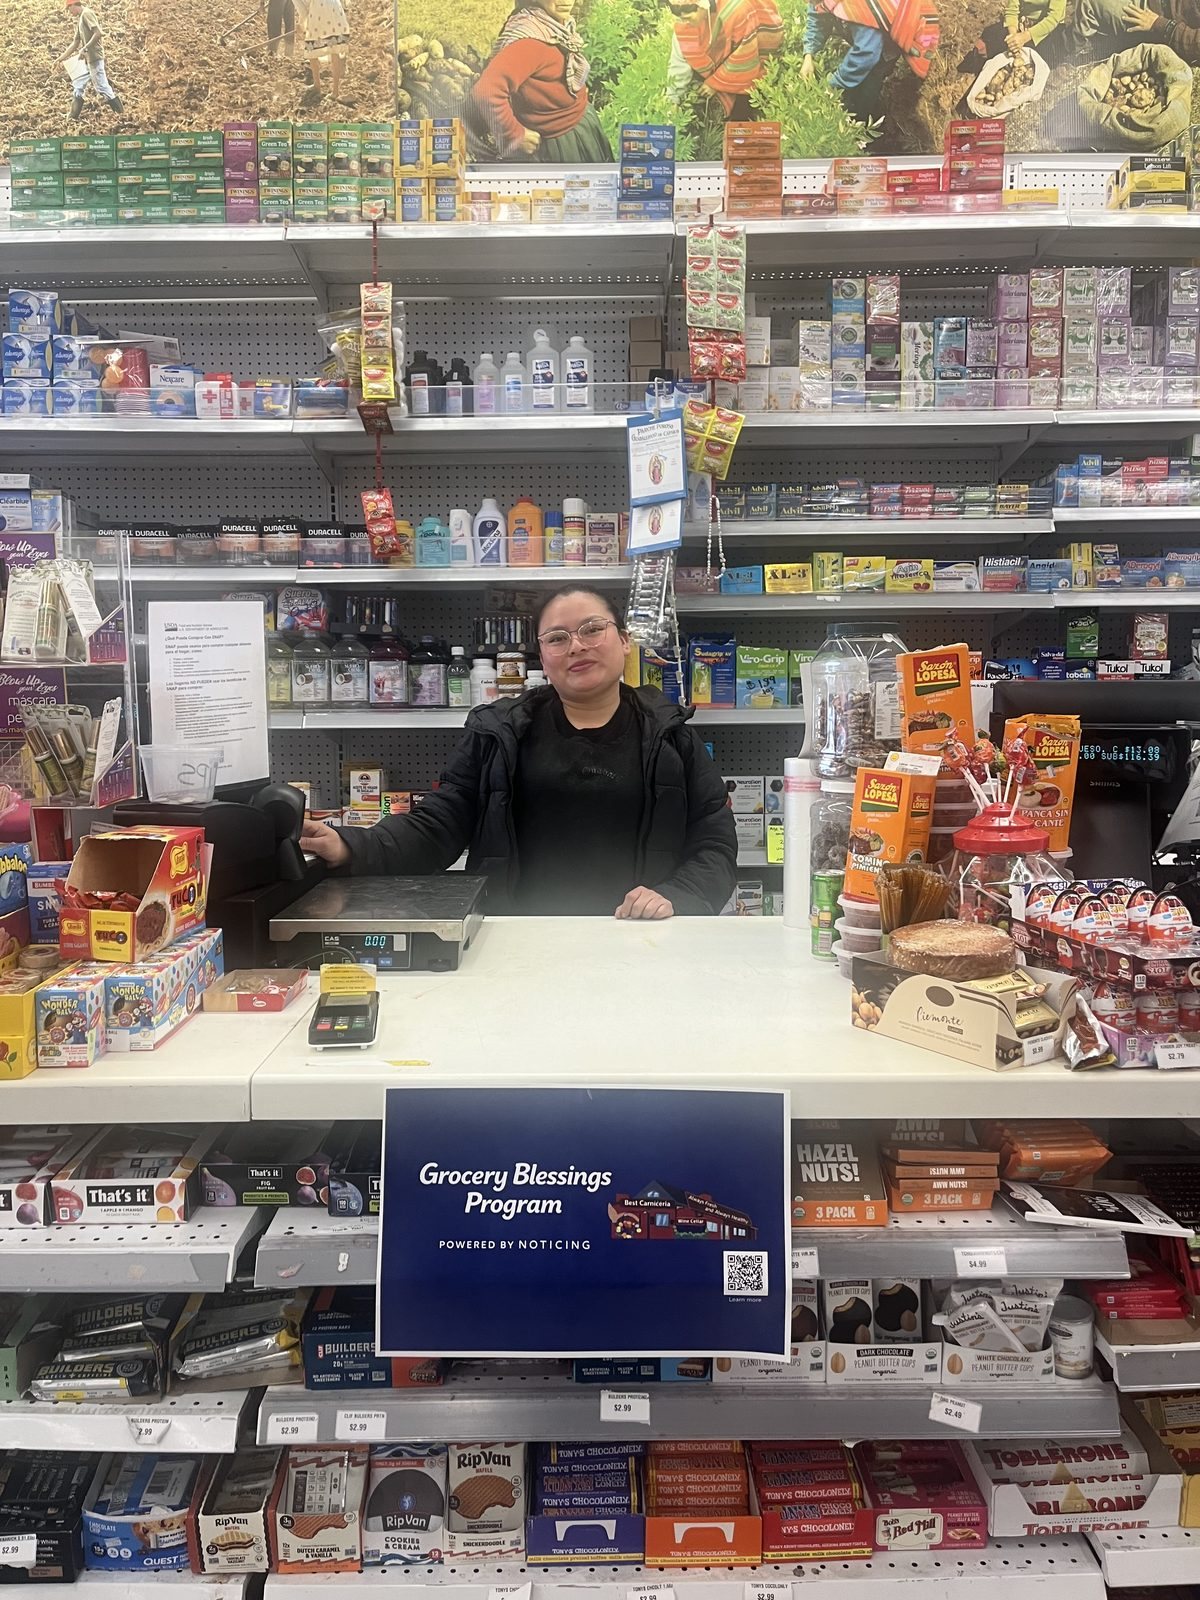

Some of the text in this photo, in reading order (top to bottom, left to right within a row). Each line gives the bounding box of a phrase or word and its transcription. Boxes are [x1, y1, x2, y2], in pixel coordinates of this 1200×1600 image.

[160, 374, 184, 385] Nexcare
[1123, 465, 1146, 473] TYLENOL
[719, 487, 741, 495] Advil
[751, 485, 768, 493] Advil
[751, 505, 768, 513] Advil
[782, 507, 803, 516] Advil
[263, 524, 297, 532] DURACELL
[984, 557, 1021, 566] Histiacil
[768, 568, 806, 579] XL-3
[740, 654, 785, 664] Viro-Grip
[919, 661, 953, 671] Sazón
[1106, 664, 1128, 672] Tukol
[1141, 663, 1163, 672] Tukol
[26, 675, 40, 685] Up
[917, 671, 957, 681] LOPESA
[8, 695, 56, 706] máscara
[1035, 746, 1069, 756] LOPESA
[868, 779, 897, 792] Sazón
[864, 789, 898, 803] LOPESA
[1022, 810, 1068, 818] PANCA SIN
[111, 985, 146, 996] WONDER
[42, 999, 78, 1010] WONDER
[916, 1006, 964, 1026] Piemonte
[797, 1144, 858, 1163] HAZEL
[419, 1162, 612, 1192] Grocery Blessings
[801, 1162, 860, 1182] NUTS!
[933, 1181, 967, 1189] AWW NUTS!
[89, 1189, 147, 1202] That's it
[688, 1196, 704, 1204] Always
[924, 1192, 962, 1204] 3 PACK
[465, 1192, 562, 1220] Program
[816, 1205, 856, 1218] 3 PACK
[715, 1210, 730, 1219] Always
[731, 1214, 748, 1224] Healthy
[519, 1240, 590, 1250] NOTICING
[1001, 1301, 1040, 1313] Justin's
[325, 1342, 375, 1354] BUILDERS
[854, 1360, 876, 1368] PEANUT
[972, 1364, 996, 1372] PEANUT
[998, 1364, 1018, 1372] BUTTER
[38, 1363, 114, 1376] BUILDERS
[944, 1408, 962, 1419] $2.49
[558, 1449, 585, 1458] TONY'S
[984, 1443, 1129, 1469] TOBLERONE
[457, 1451, 511, 1469] RipVan
[543, 1464, 569, 1473] TONY'S
[657, 1474, 683, 1482] TONY'S
[765, 1492, 792, 1500] TONY'S
[543, 1498, 569, 1506] TONY'S
[215, 1517, 248, 1527] RipVan
[387, 1515, 426, 1528] Rip Van
[882, 1518, 900, 1526] Bob's
[894, 1525, 914, 1538] Red
[915, 1518, 936, 1534] Mill
[143, 1556, 178, 1566] QUEST
